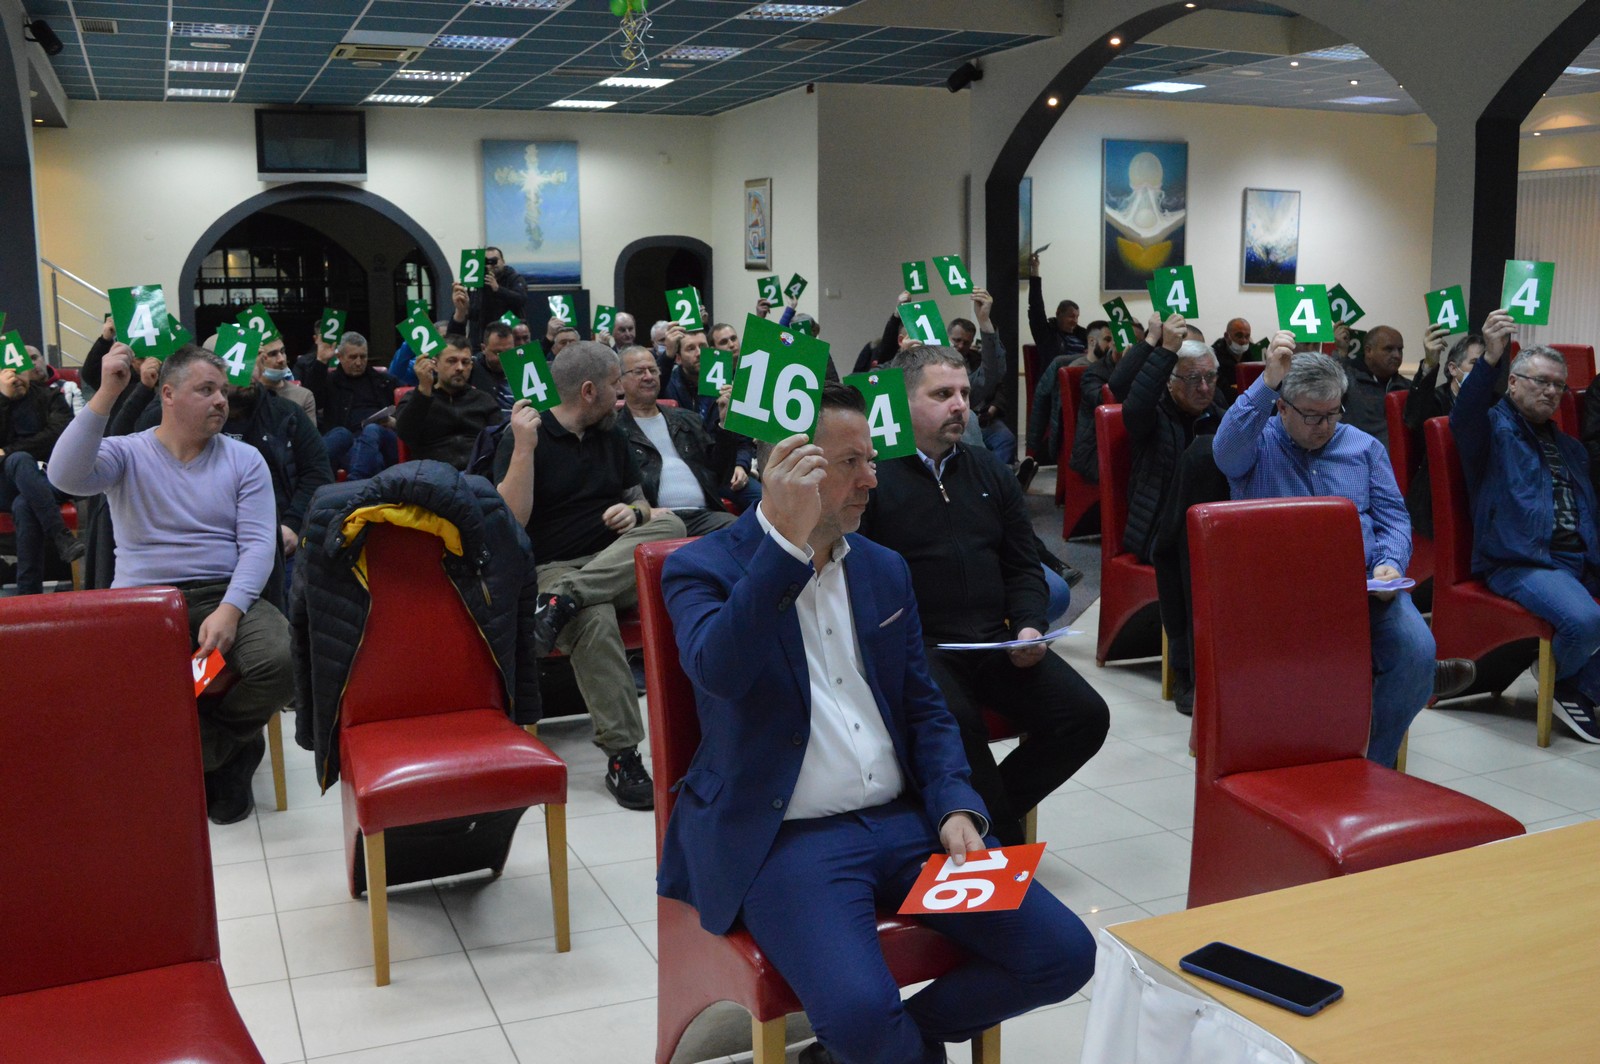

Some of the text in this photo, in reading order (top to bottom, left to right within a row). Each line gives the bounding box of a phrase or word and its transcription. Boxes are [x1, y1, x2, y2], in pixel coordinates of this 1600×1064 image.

[464, 259, 479, 282] 2
[910, 270, 923, 290] 1
[949, 265, 966, 289] 4
[763, 285, 779, 304] 2
[789, 283, 802, 297] 4
[1166, 280, 1190, 312] 4
[1510, 278, 1540, 315] 4
[128, 303, 161, 346] 4
[597, 313, 611, 331] 2
[674, 300, 696, 326] 2
[1290, 299, 1322, 334] 4
[1331, 298, 1357, 323] 2
[1436, 300, 1460, 329] 4
[324, 318, 340, 340] 2
[412, 326, 438, 354] 2
[916, 315, 942, 345] 1
[1118, 328, 1133, 347] 1
[5, 343, 25, 368] 4
[222, 342, 247, 377] 4
[1348, 339, 1361, 360] 2
[522, 362, 548, 402] 4
[706, 361, 726, 390] 4
[731, 350, 819, 433] 16
[867, 394, 901, 447] 4
[921, 850, 1009, 910] 16
